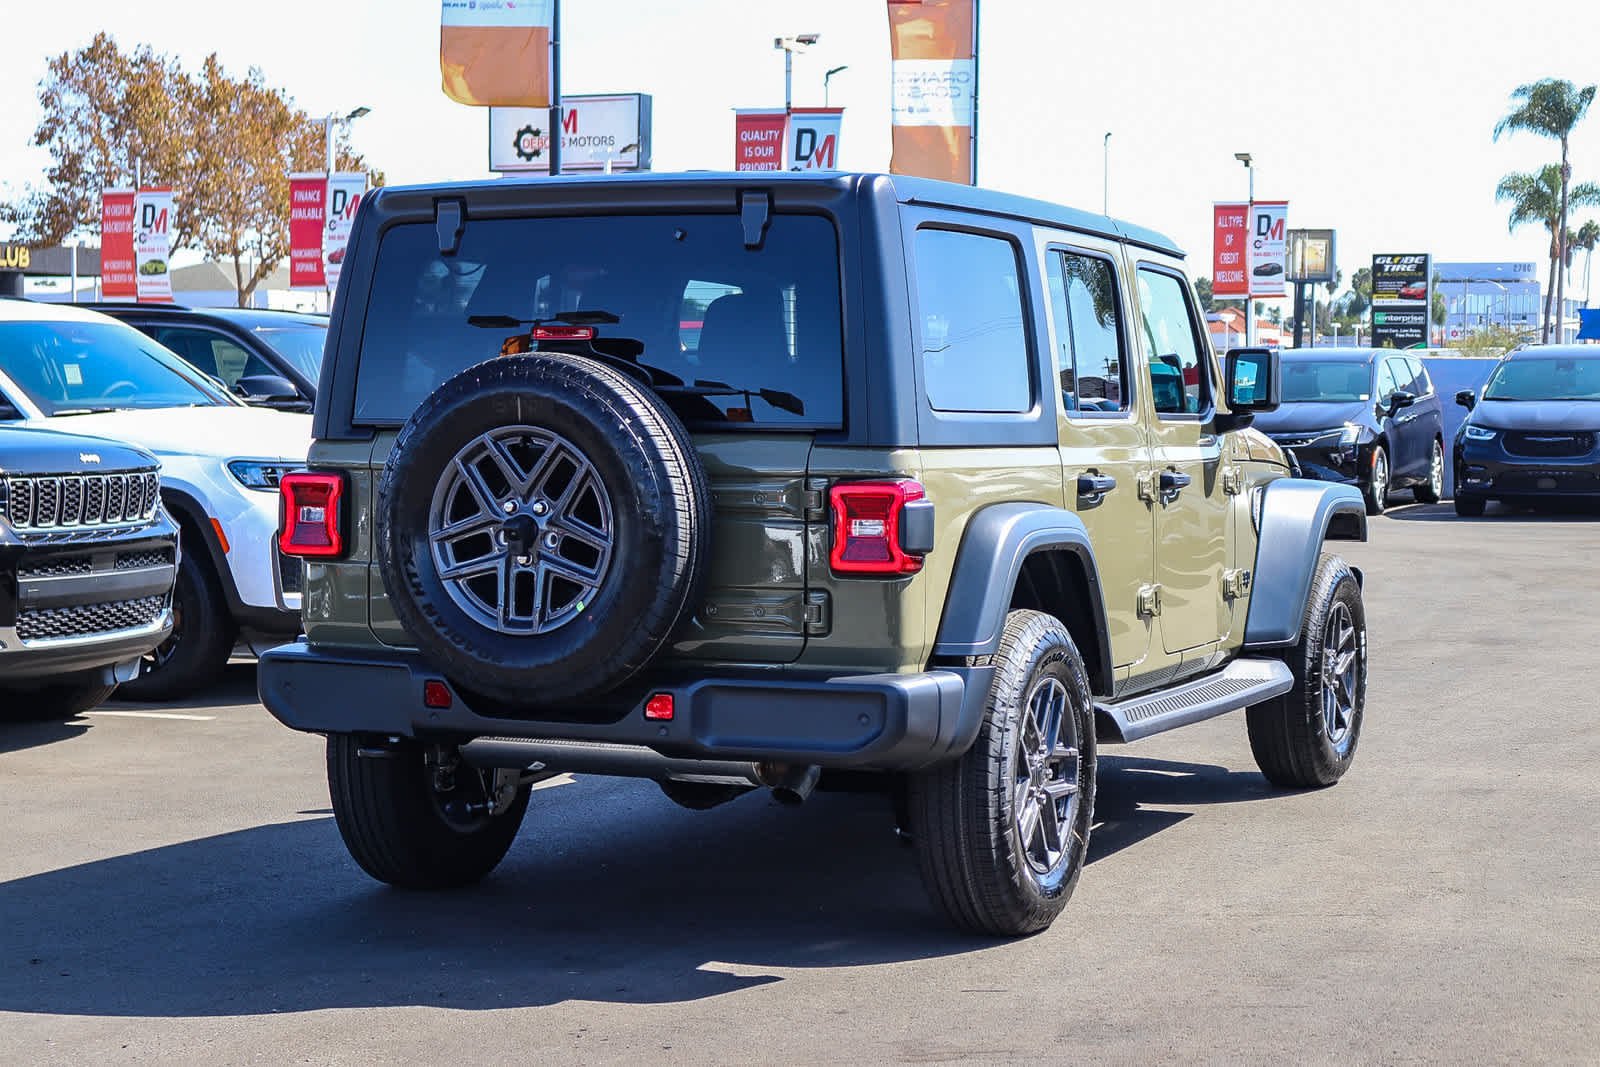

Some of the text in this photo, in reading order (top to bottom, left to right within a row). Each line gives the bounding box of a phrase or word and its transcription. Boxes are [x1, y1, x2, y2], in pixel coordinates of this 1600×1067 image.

[569, 136, 615, 147] MOTORS
[741, 130, 780, 142] QUALITY
[745, 147, 775, 157] IS OUR
[795, 128, 835, 168] DM
[740, 162, 780, 170] PRIORITY
[294, 190, 321, 202] FINANCE
[142, 203, 167, 234] DM
[292, 207, 323, 219] AVAILABLE
[1218, 215, 1243, 227] ALL TYPE
[1257, 214, 1285, 240] DM
[1225, 234, 1234, 246] OF
[1220, 252, 1239, 264] CREDIT
[1384, 264, 1417, 272] TIRE
[1216, 270, 1244, 282] WELCOME
